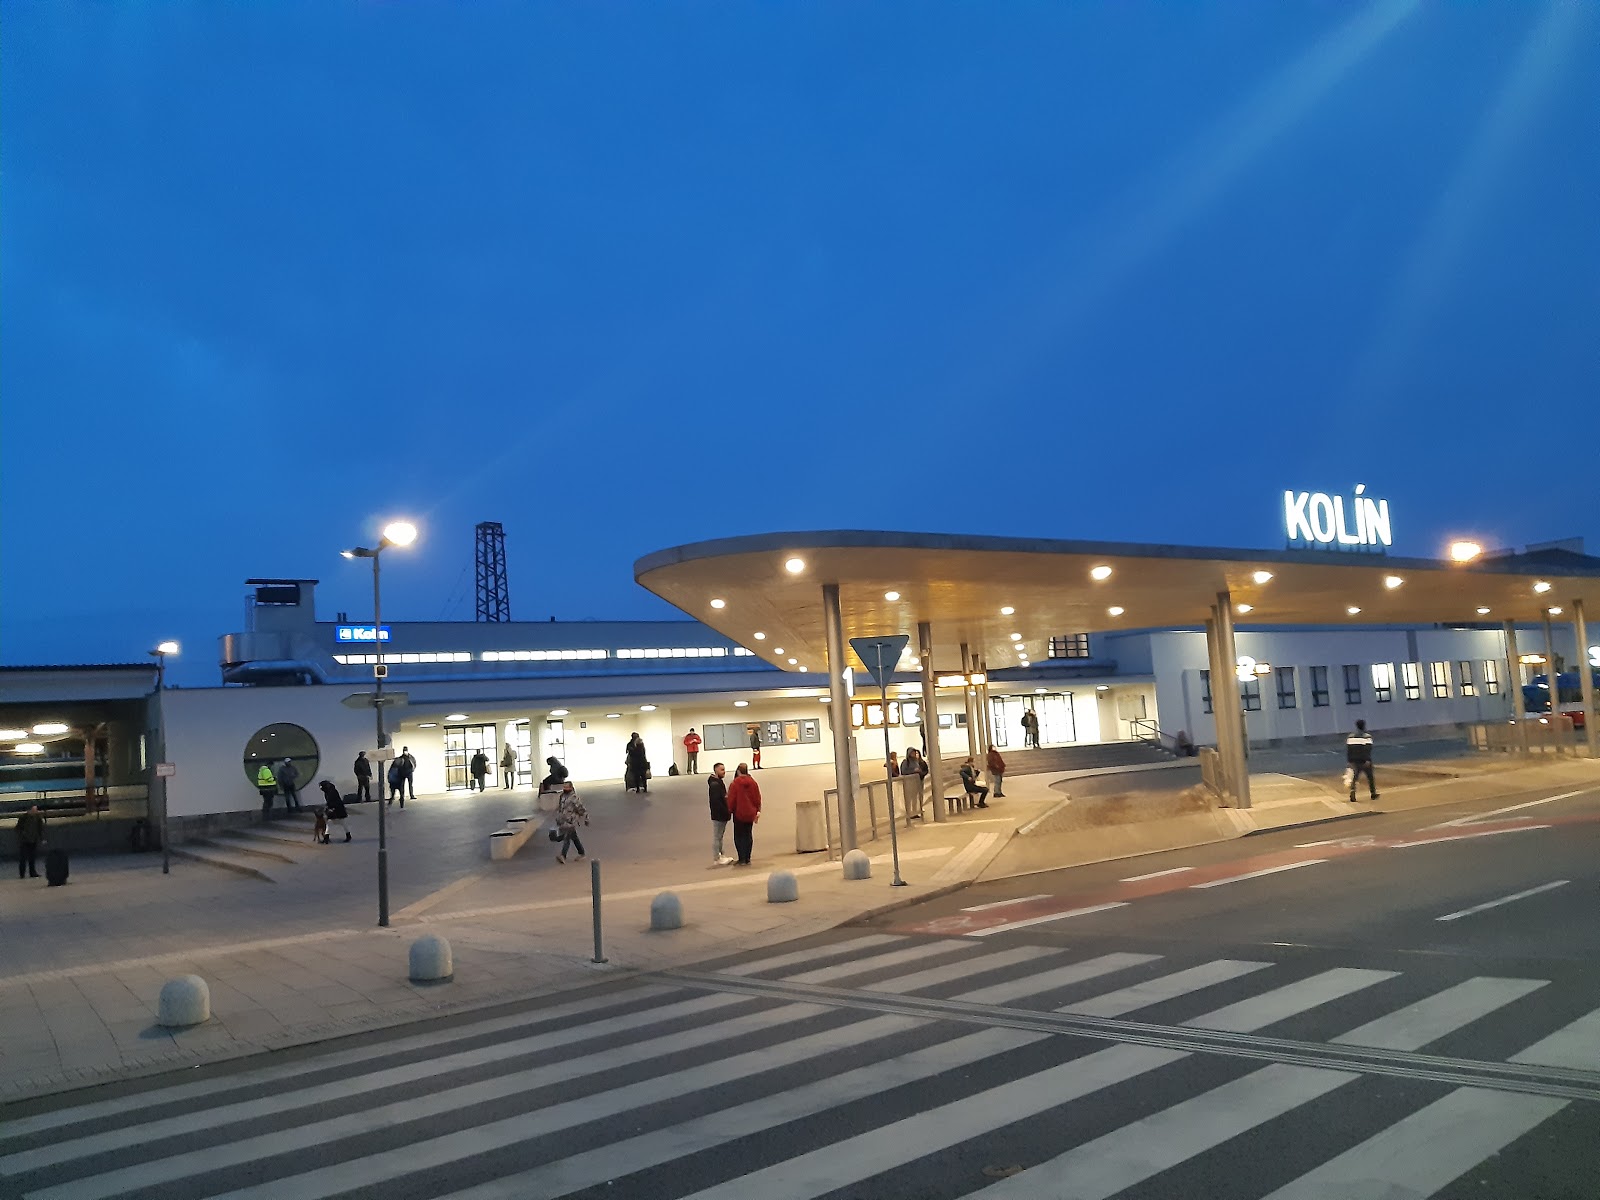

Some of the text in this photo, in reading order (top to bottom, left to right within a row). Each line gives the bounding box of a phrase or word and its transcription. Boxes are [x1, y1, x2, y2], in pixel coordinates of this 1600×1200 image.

[1284, 483, 1392, 546] KOLÍN
[353, 628, 388, 640] Koln
[842, 666, 854, 697] 1
[1237, 655, 1258, 682] 2
